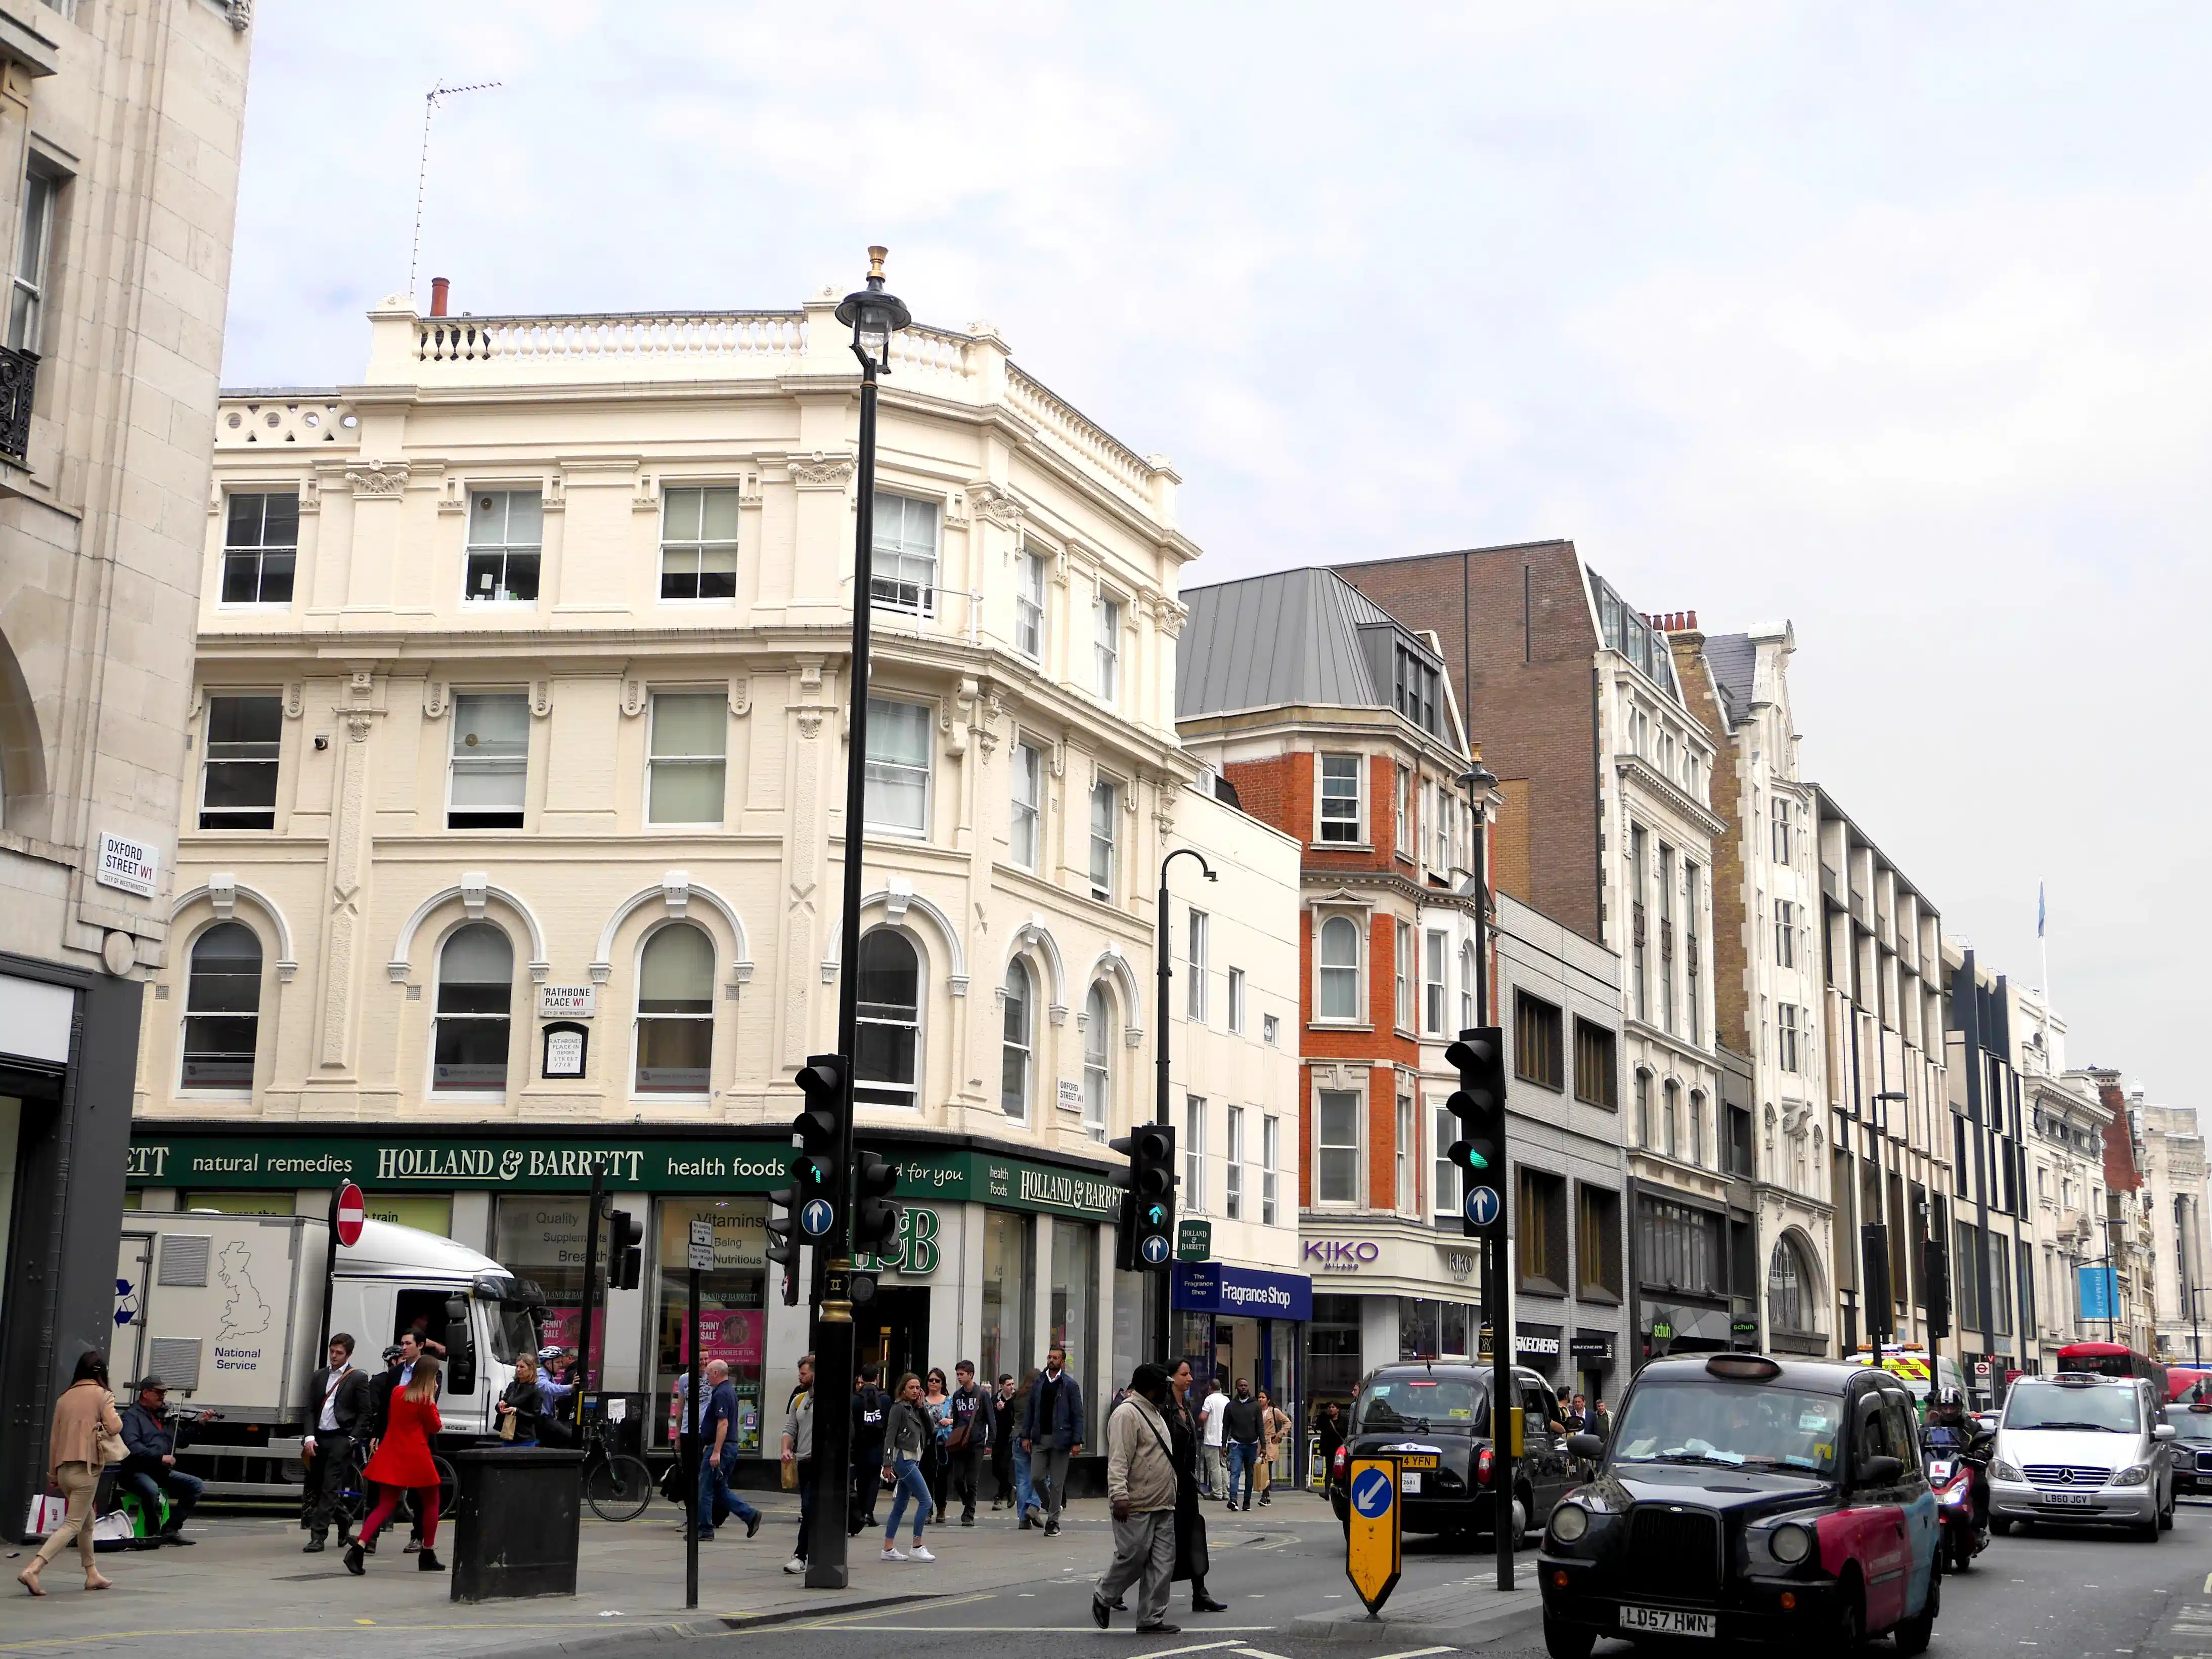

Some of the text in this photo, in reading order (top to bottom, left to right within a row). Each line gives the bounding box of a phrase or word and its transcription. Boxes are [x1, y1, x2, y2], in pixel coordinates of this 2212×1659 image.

[108, 839, 142, 861] OXFORD
[106, 855, 152, 880] STREET W1
[119, 880, 148, 893] WESTMINSTER
[545, 988, 590, 996] RATHBONE
[545, 998, 584, 1006] PLACE W1
[1060, 1081, 1078, 1092] OXFORD
[1060, 1090, 1076, 1101] STREET
[193, 1154, 353, 1172] natural remedies
[376, 1149, 645, 1181] HOLLAND & BARRETT
[668, 1157, 786, 1177] health foods
[907, 1163, 931, 1183] for
[934, 1169, 964, 1187] you
[989, 1165, 1009, 1182] health
[989, 1182, 1008, 1197] foods
[1020, 1170, 1130, 1209] HOLLAND & BARRET
[372, 1211, 398, 1223] train
[536, 1212, 579, 1227] Quality
[543, 1233, 607, 1244] Supplemts
[1182, 1230, 1207, 1238] HOLLAND
[714, 1238, 742, 1249] Being
[1181, 1243, 1206, 1251] BARRETT
[1304, 1240, 1379, 1262] KIKO
[714, 1254, 762, 1264] Nutritious
[1449, 1252, 1473, 1273] KIKO
[1324, 1262, 1359, 1271] MILANO
[1221, 1281, 1291, 1309] Fragrance Shop
[2094, 1270, 2104, 1314] PRIMARK
[699, 1321, 720, 1330] PENNY
[1654, 1322, 1671, 1338] schuh
[544, 1330, 559, 1338] SALE
[700, 1332, 717, 1340] SALE
[1516, 1336, 1559, 1354] SKECHERS
[214, 1347, 261, 1359] National
[216, 1360, 257, 1370] Service
[1412, 1456, 1431, 1466] YFN
[1934, 1464, 1945, 1473] L
[2045, 1494, 2087, 1504] LB60 JGV
[1626, 1607, 1708, 1633] LD57 HWN
